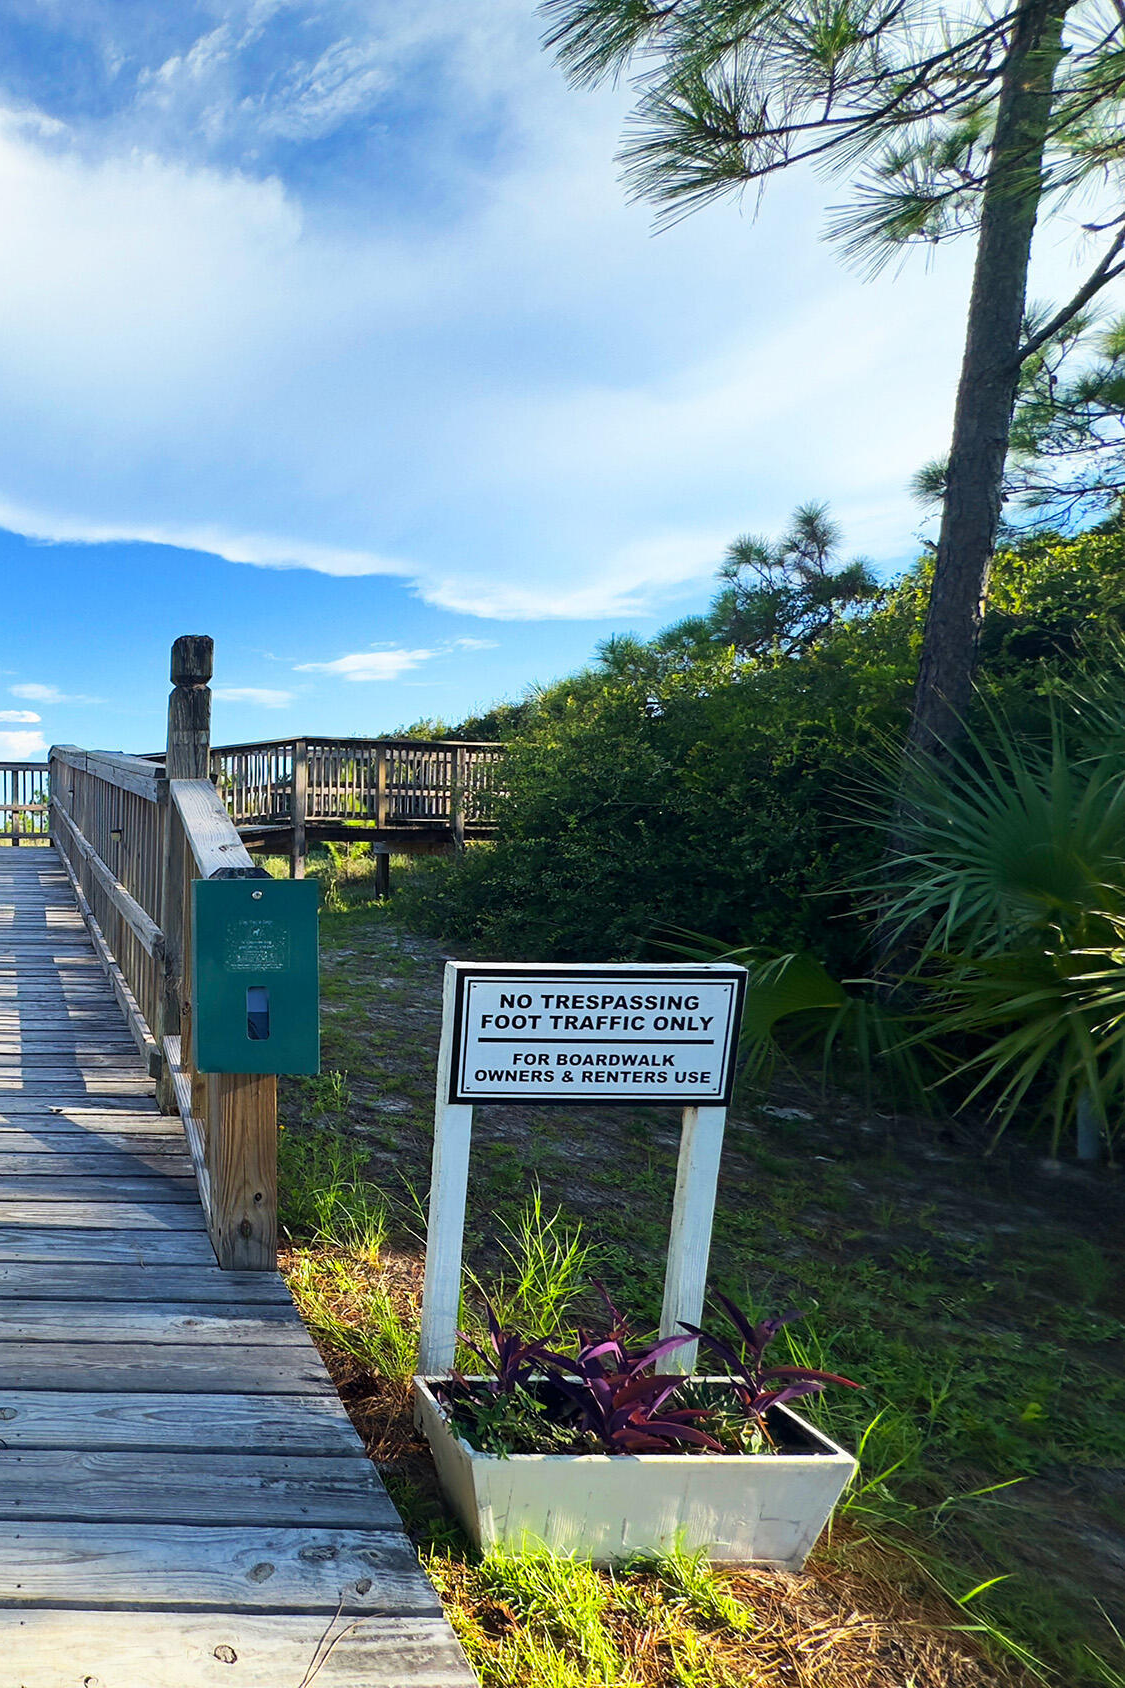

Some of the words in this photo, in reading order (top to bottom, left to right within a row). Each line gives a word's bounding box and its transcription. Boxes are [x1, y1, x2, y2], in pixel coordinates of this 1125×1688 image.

[500, 994, 532, 1009] NO
[541, 994, 700, 1010] TRESPASSING
[481, 1015, 541, 1029] FOOT
[550, 1015, 645, 1031] TRAFFIC
[653, 1016, 714, 1031] ONLY
[513, 1053, 549, 1066] FOR
[557, 1054, 675, 1067] BOARDWALK
[474, 1070, 554, 1082] OWNERS
[562, 1071, 575, 1082] &
[582, 1071, 668, 1083] RENTERS
[674, 1071, 711, 1084] USE
